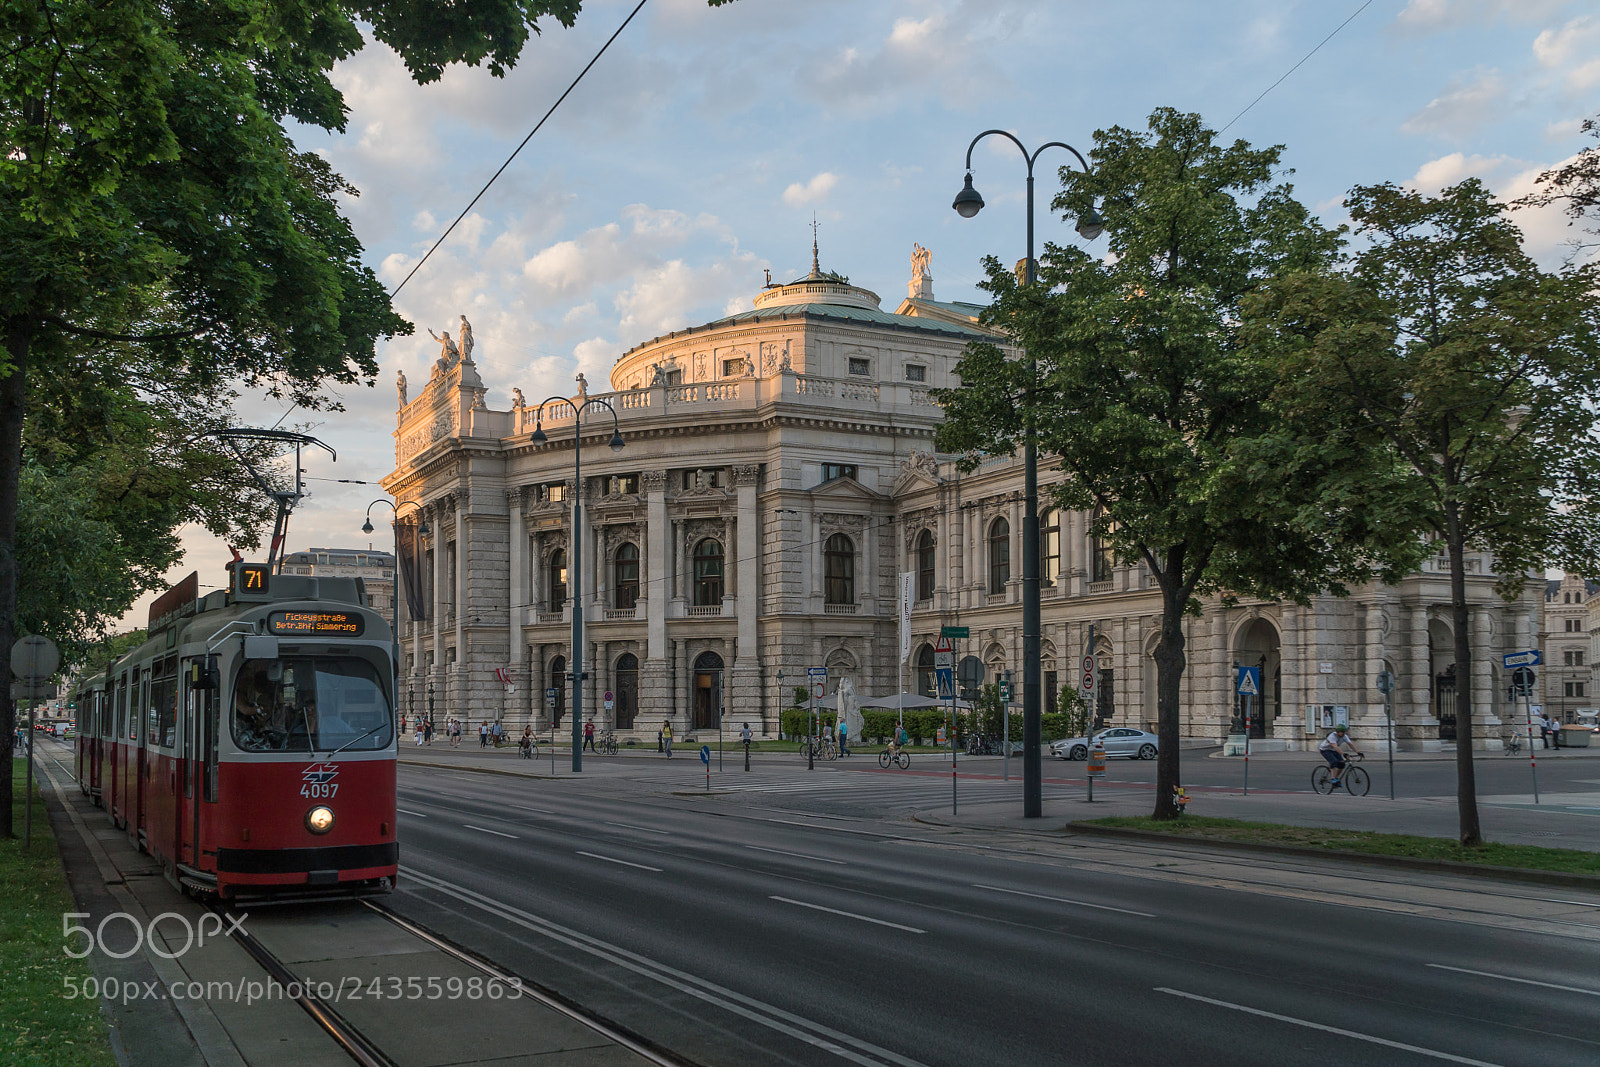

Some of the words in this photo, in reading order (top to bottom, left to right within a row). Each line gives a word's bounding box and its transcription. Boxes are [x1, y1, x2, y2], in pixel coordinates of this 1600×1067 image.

[245, 570, 262, 588] 71
[285, 613, 347, 622] Fickeysstraße
[300, 783, 339, 799] 4097
